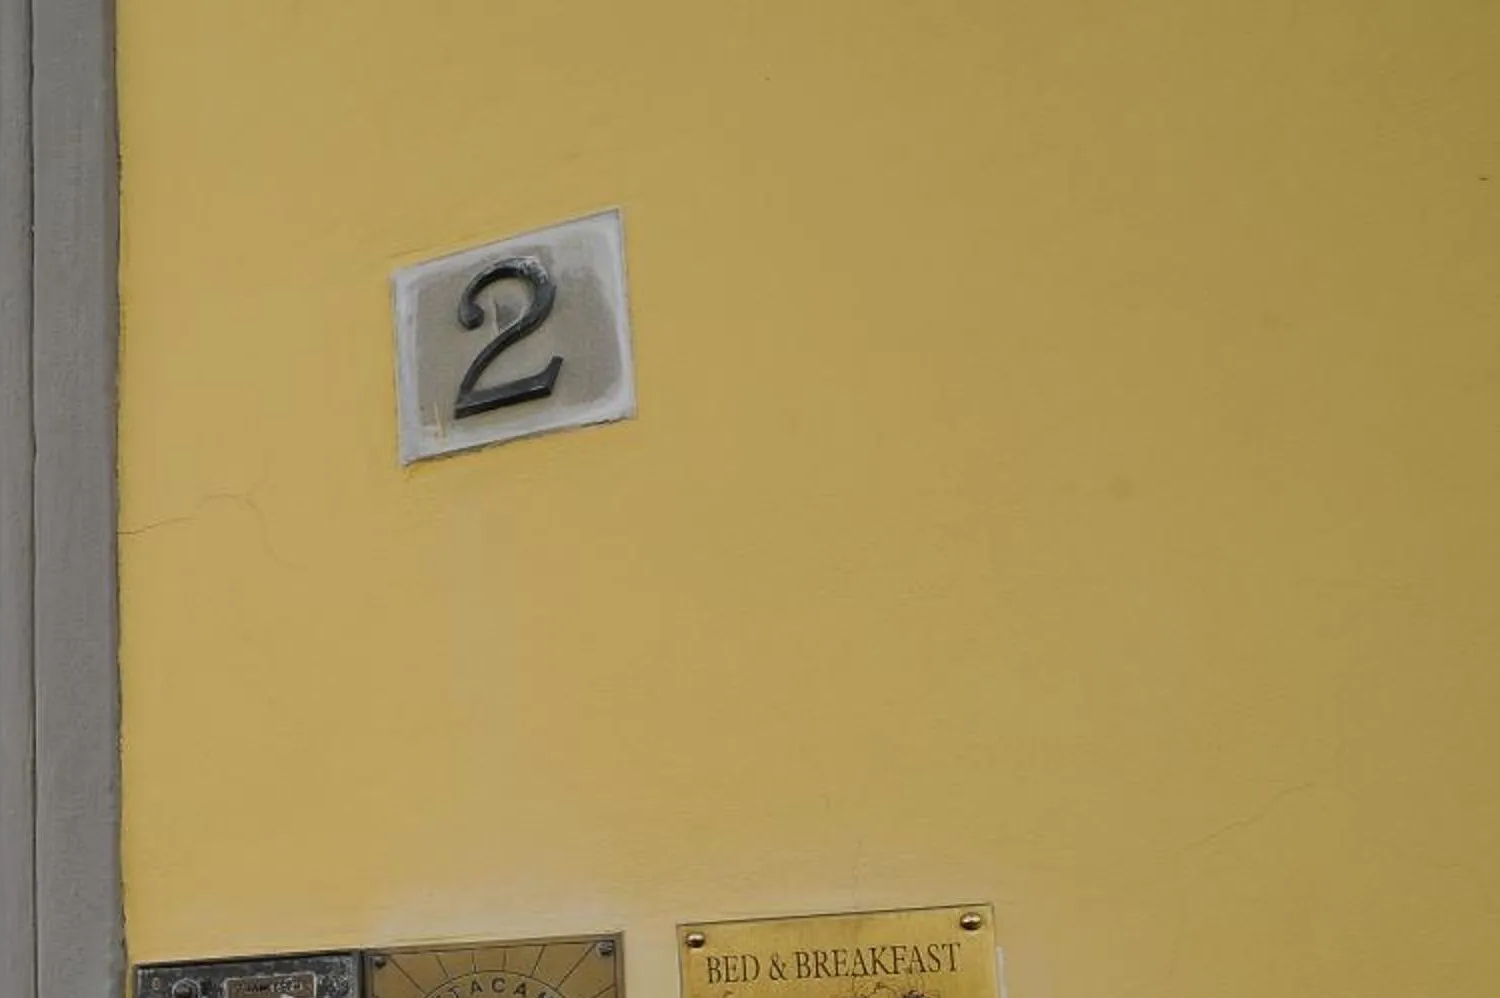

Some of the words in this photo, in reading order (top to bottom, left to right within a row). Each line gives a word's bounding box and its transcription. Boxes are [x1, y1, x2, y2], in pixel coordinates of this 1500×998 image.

[454, 257, 563, 419] 2
[707, 954, 760, 984] BED
[768, 952, 789, 981] &
[796, 943, 962, 978] BREAKFAST
